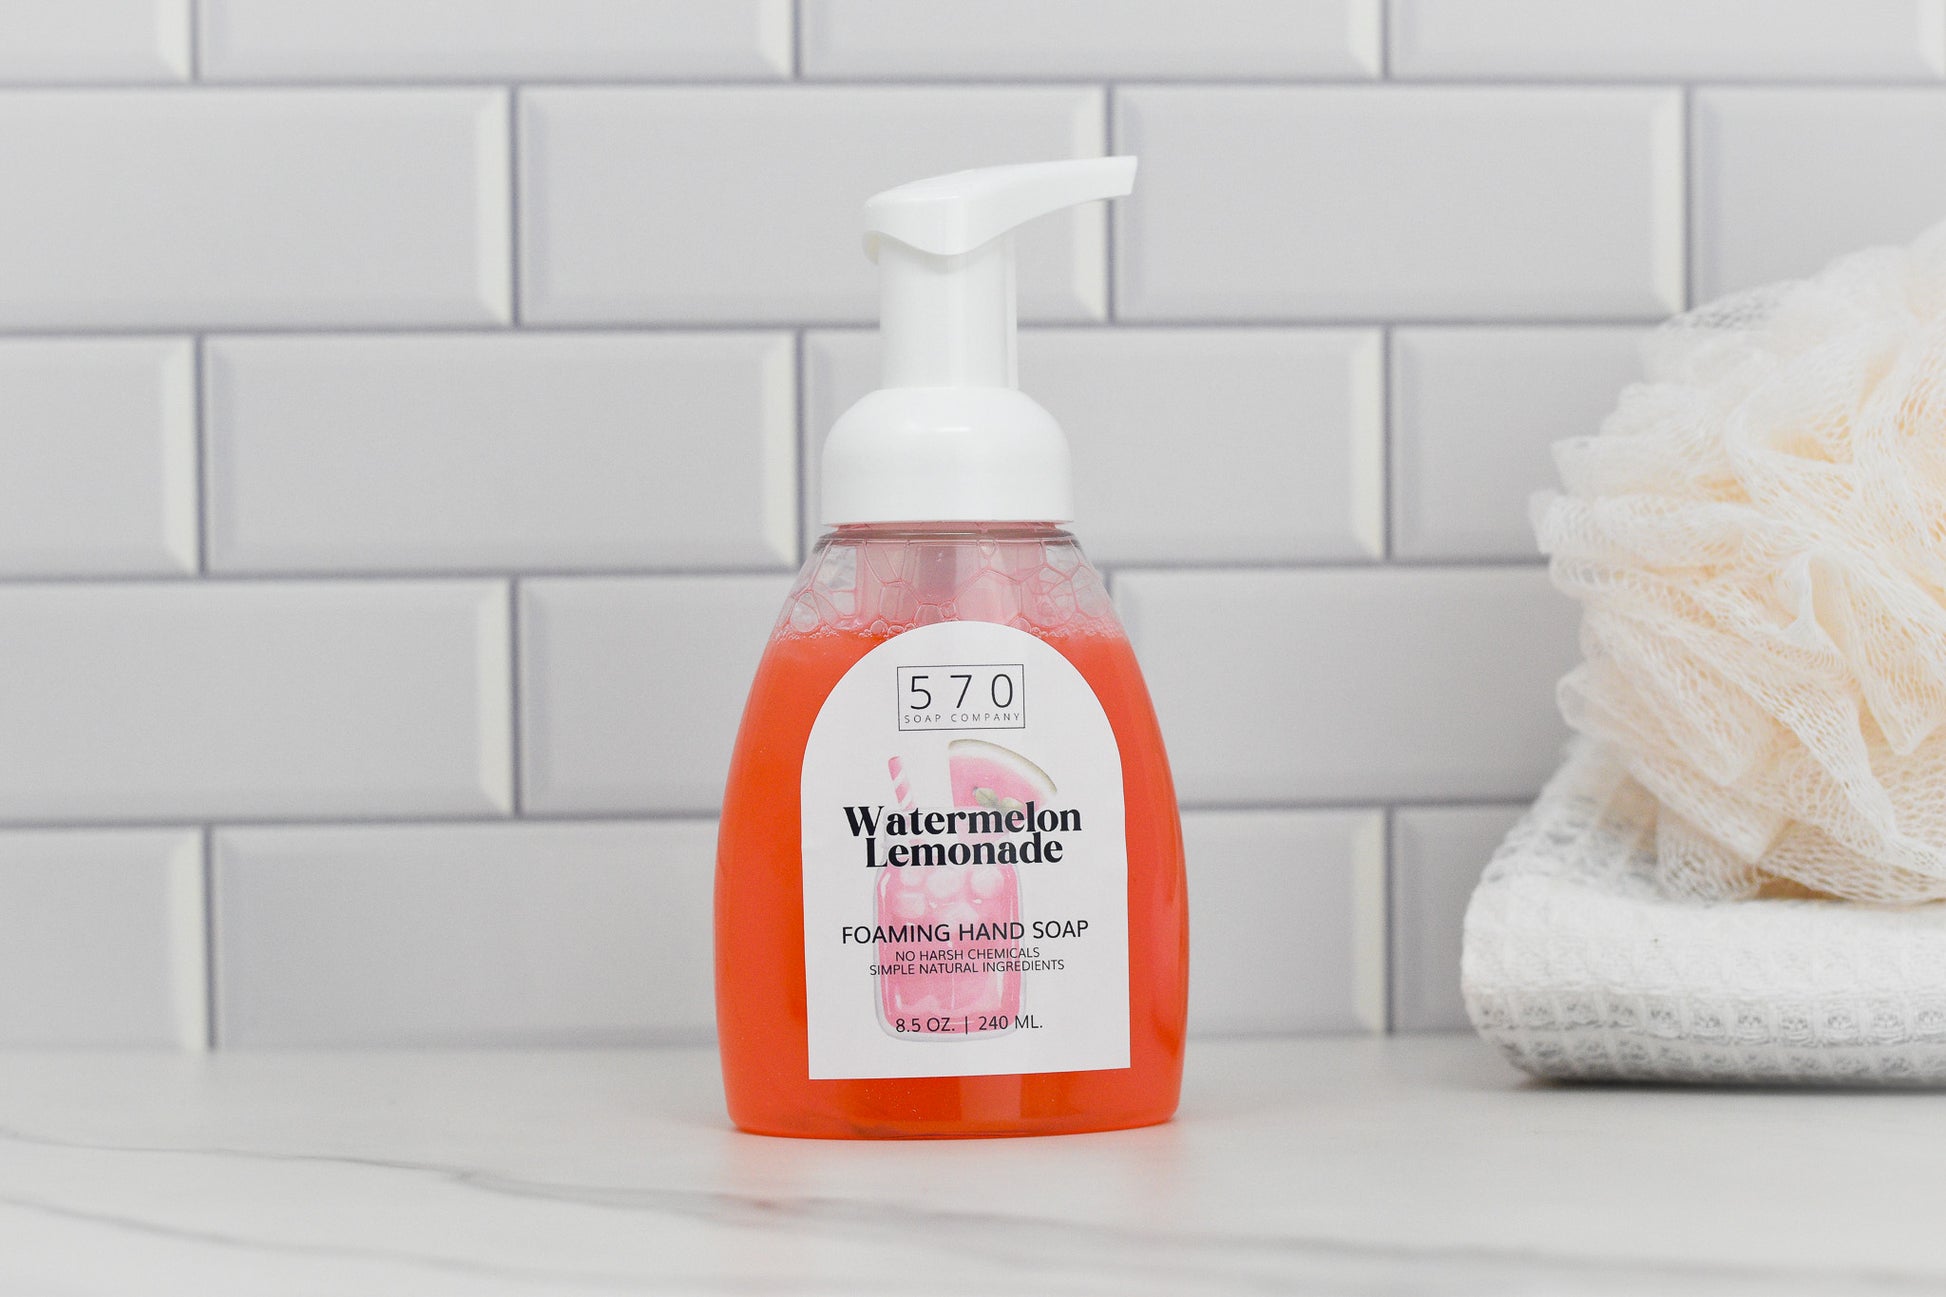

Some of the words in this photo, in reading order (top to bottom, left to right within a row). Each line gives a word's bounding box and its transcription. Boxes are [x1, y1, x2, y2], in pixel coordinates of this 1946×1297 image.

[904, 714, 942, 724] SOAP
[950, 712, 1021, 723] COMPANY
[843, 801, 1082, 837] Watermelon
[865, 832, 1063, 868] Lemonade
[842, 923, 951, 944] FOAMING
[959, 922, 1025, 942] HAND
[1032, 920, 1089, 940] SOAP
[895, 950, 916, 962] NO
[920, 949, 964, 961] HARSH
[967, 947, 1040, 960] CHEMICALS
[869, 964, 915, 976] SIMPLE
[919, 962, 979, 974] NATURAL
[982, 959, 1065, 973] INGREDIENTS
[895, 1018, 921, 1033] 8.5
[926, 1017, 956, 1032] OZ.
[978, 1016, 1009, 1031] 240
[1014, 1015, 1043, 1029] ML.
